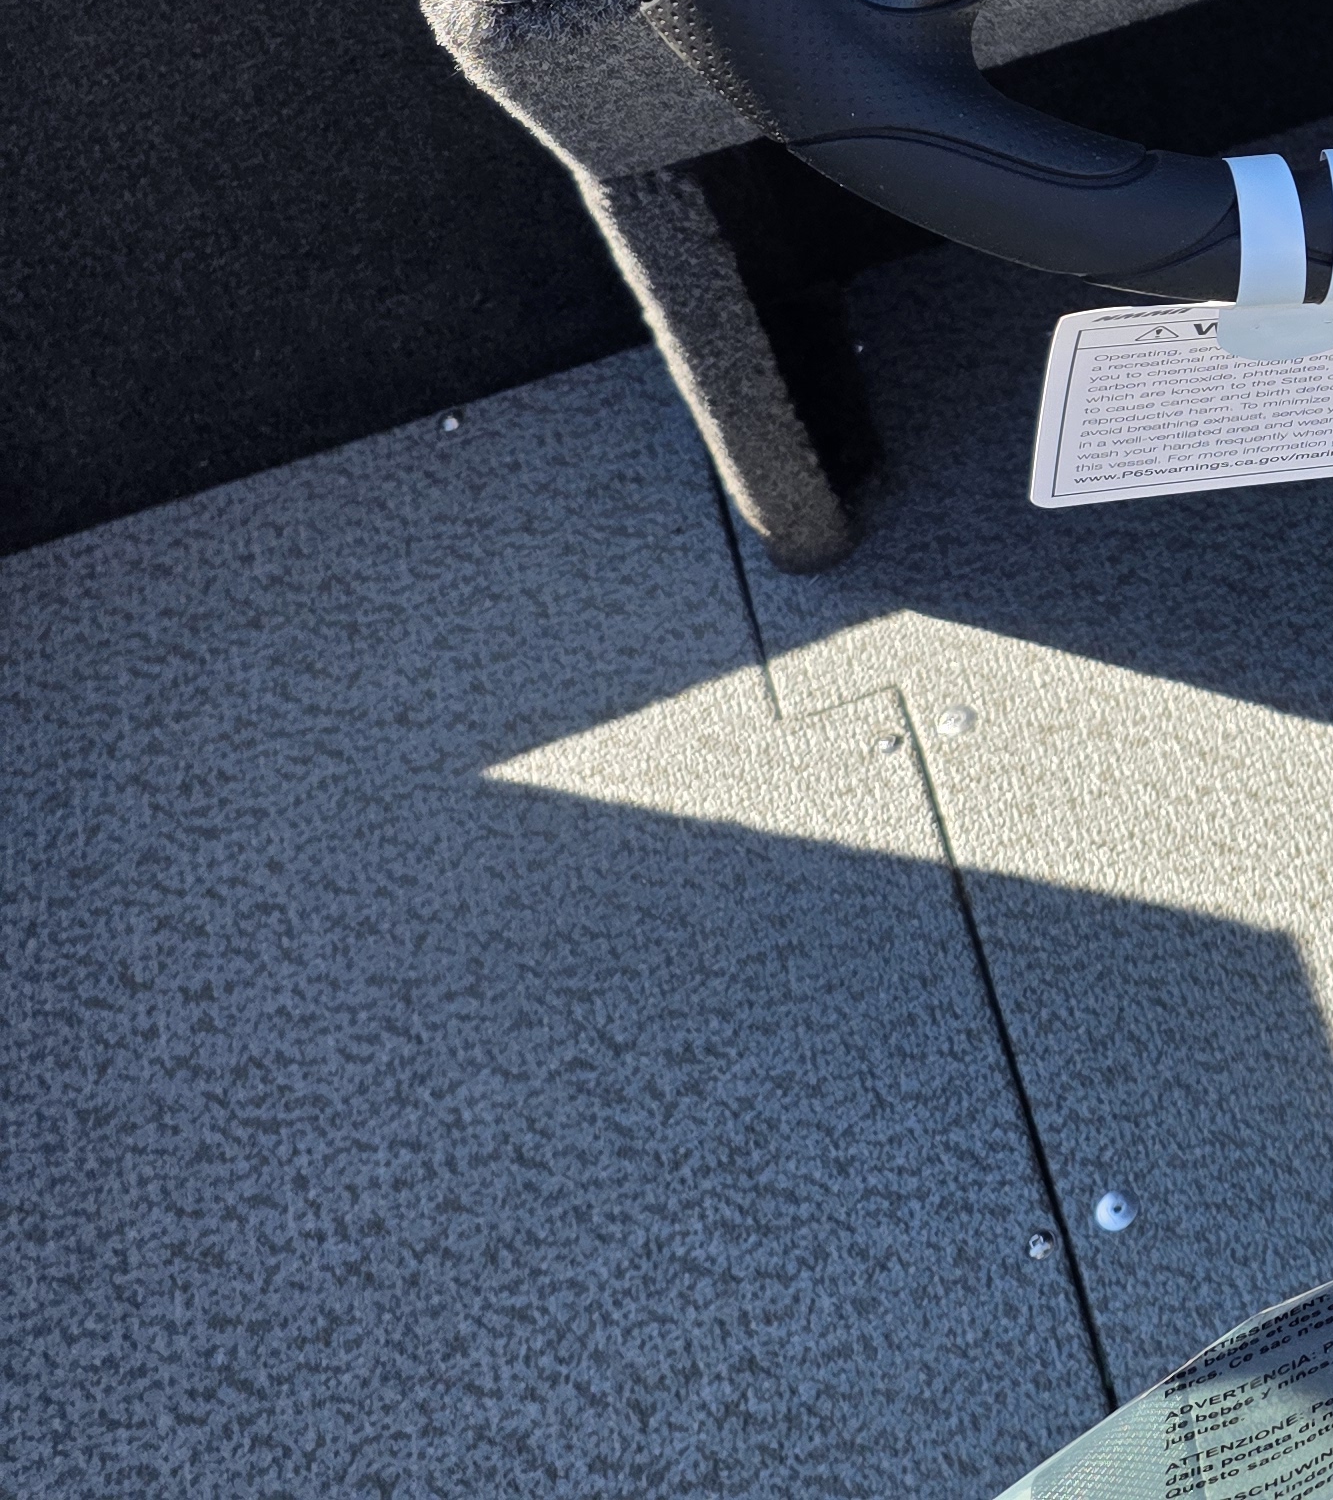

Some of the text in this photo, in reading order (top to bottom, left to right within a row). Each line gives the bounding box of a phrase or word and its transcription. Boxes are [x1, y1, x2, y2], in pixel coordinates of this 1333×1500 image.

[1094, 348, 1182, 362] Operating,
[1108, 355, 1205, 371] recreational
[1087, 364, 1330, 393] carbon monoxide, phthalates,
[1147, 363, 1229, 377] chemicals
[1085, 392, 1135, 404] which
[1171, 384, 1225, 396] known
[1280, 374, 1324, 385] State
[1105, 401, 1156, 413] cause
[1160, 396, 1216, 407] cancer
[1220, 391, 1251, 401] and
[1255, 388, 1291, 398] birth
[1082, 409, 1184, 426] reproductive
[1188, 405, 1234, 416] harm.
[1263, 395, 1331, 408] minimize
[1080, 427, 1123, 438] avoid
[1127, 419, 1200, 434] breathing
[1112, 427, 1223, 446] well-ventilated
[1162, 431, 1289, 452] hands frequently
[1108, 439, 1327, 469] vessel. information
[1165, 1350, 1317, 1423] ADVERTENCIA:
[1164, 1412, 1304, 1476] ATTENZIONE:
[1165, 1462, 1214, 1488] dalla
[1220, 1434, 1293, 1468] portata
[1165, 1468, 1240, 1500] Questo
